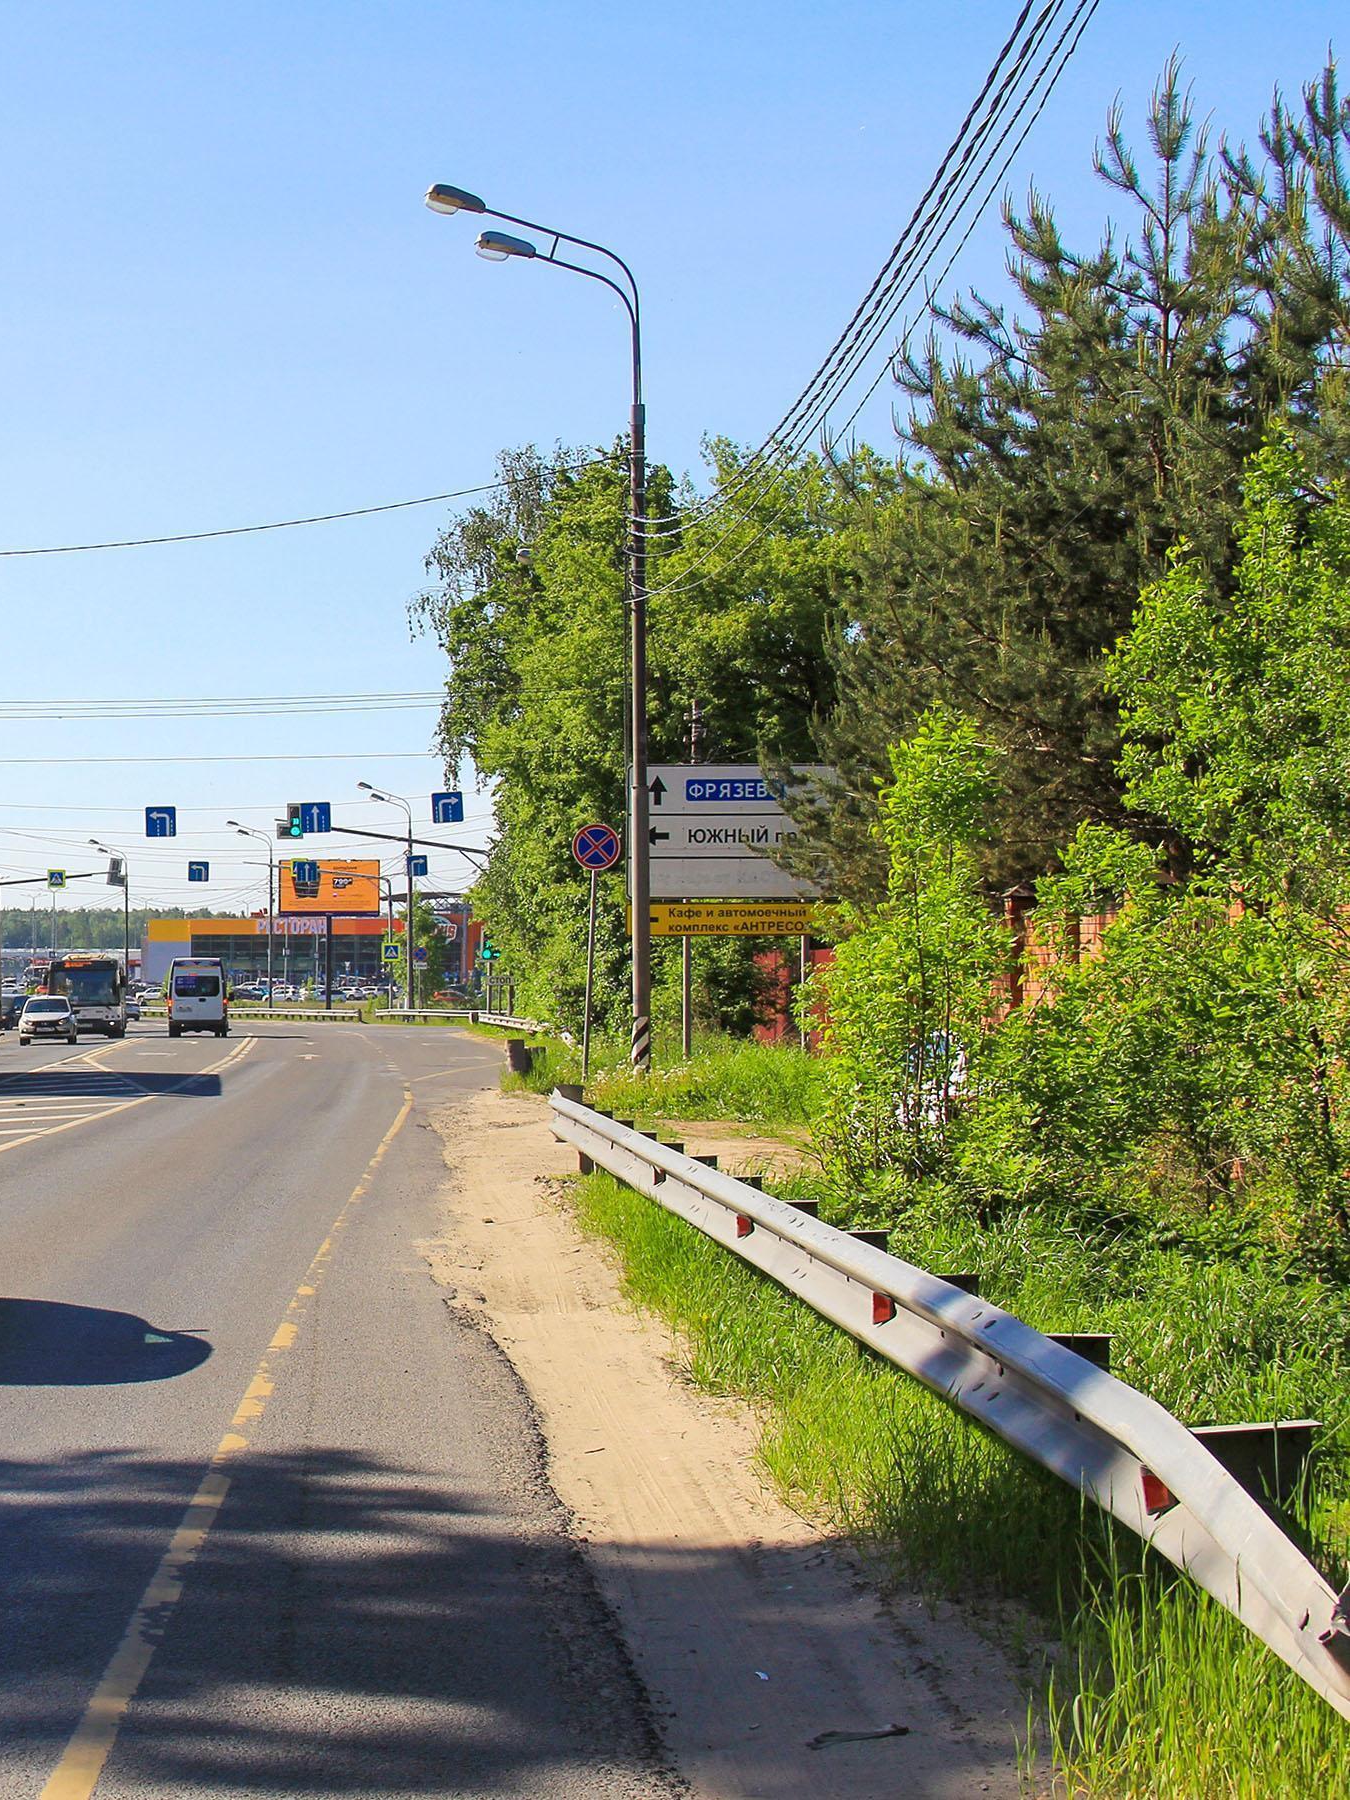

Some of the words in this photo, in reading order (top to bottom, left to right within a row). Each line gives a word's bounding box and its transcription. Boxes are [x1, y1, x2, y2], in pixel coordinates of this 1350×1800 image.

[688, 825, 769, 843] ЮЖНЫЙ
[668, 907, 703, 919] Кафе
[706, 909, 714, 918] и
[717, 907, 807, 918] автомоечный
[668, 922, 729, 932] комплекс
